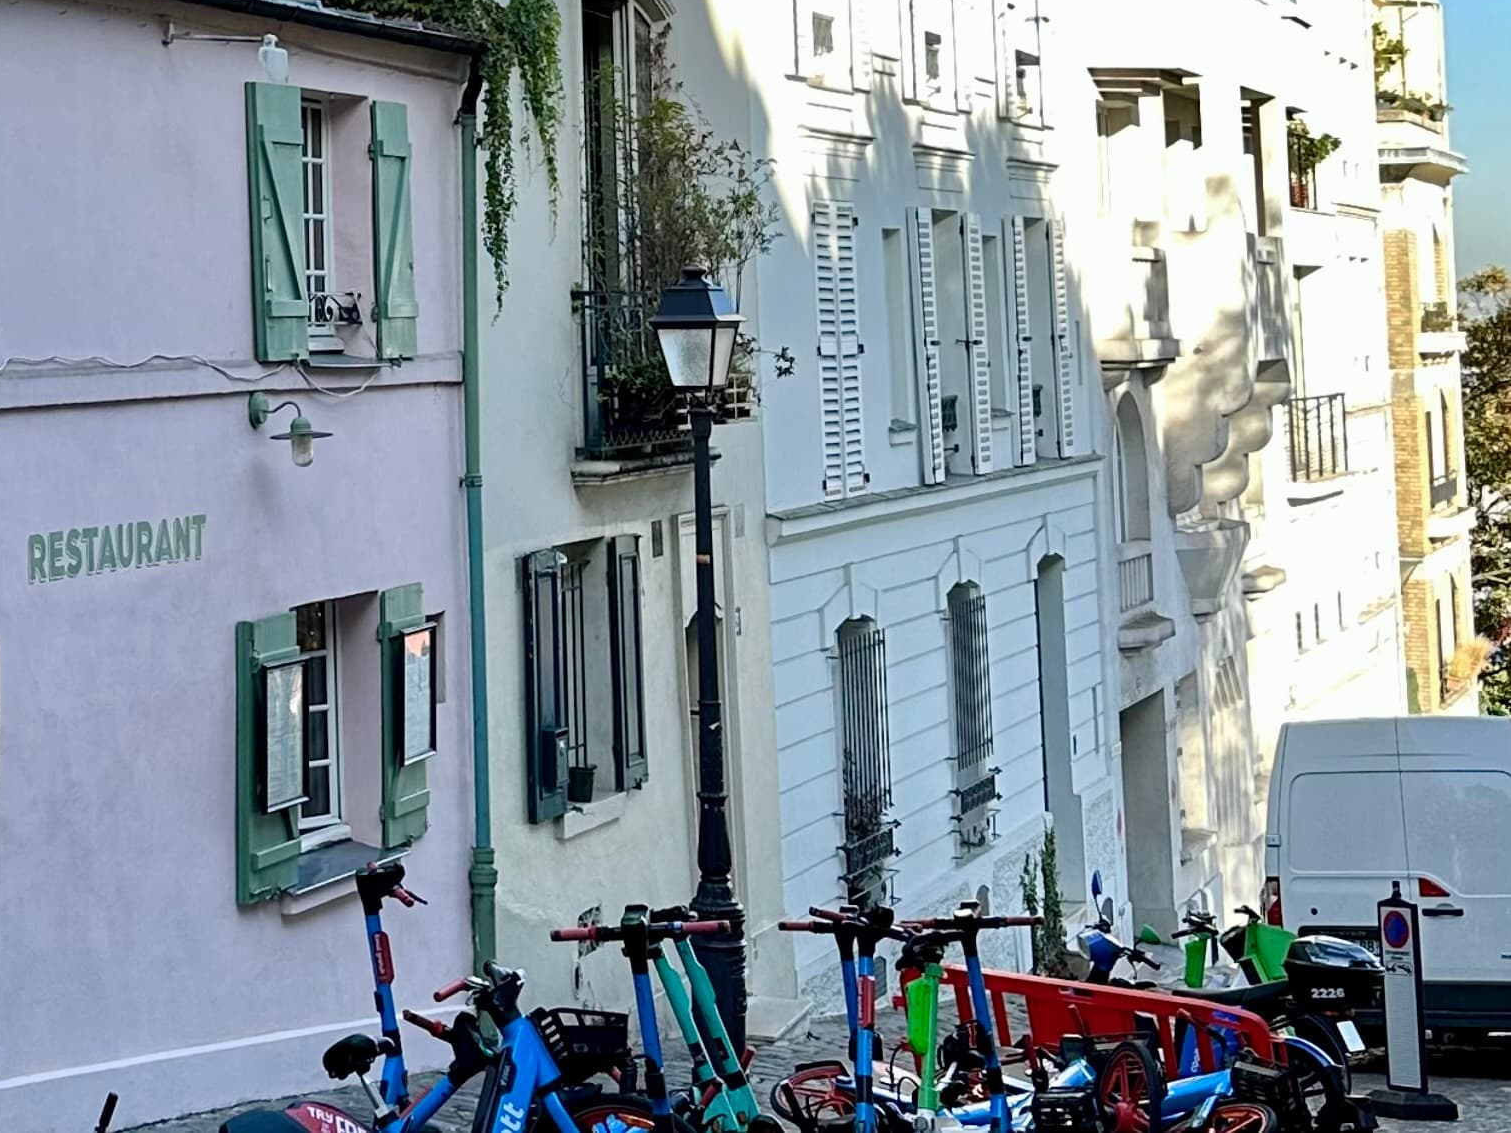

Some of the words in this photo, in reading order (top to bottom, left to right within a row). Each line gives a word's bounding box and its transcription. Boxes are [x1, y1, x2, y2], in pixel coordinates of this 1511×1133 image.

[27, 515, 207, 585] RESTAURANT
[1311, 988, 1345, 999] 2226
[306, 1106, 334, 1124] TRY
